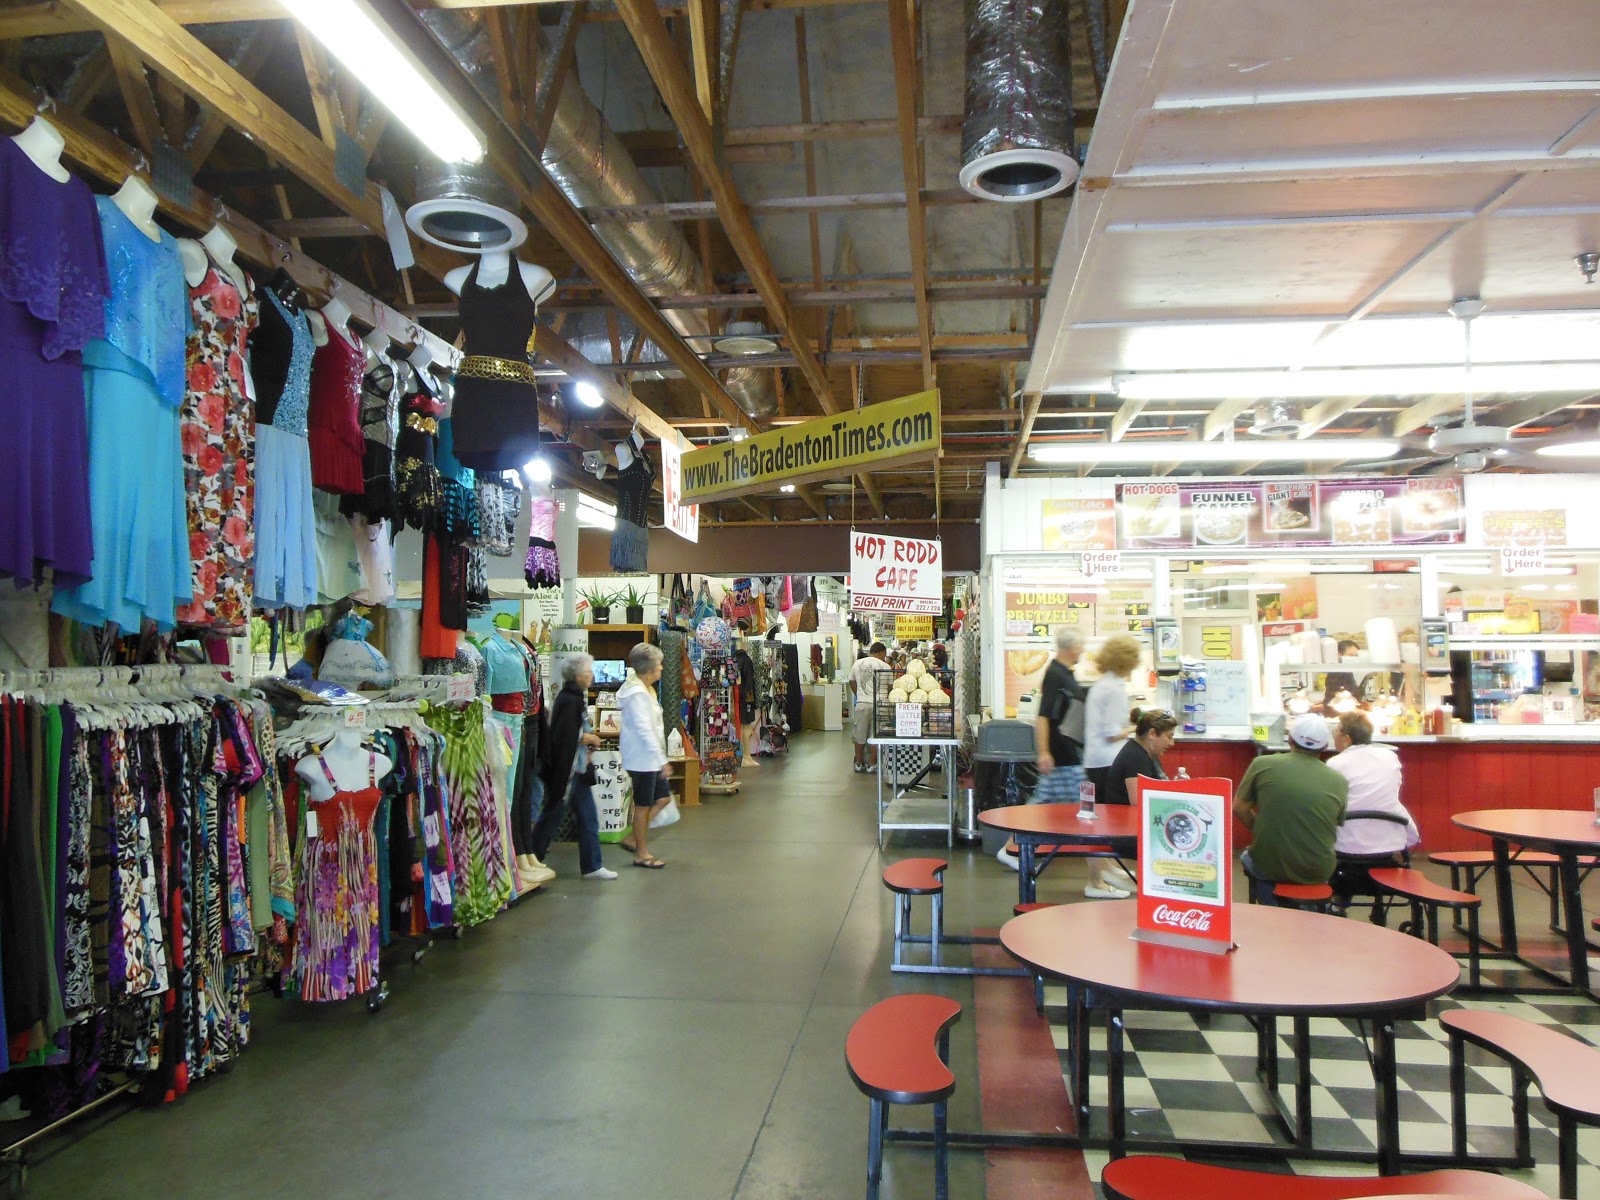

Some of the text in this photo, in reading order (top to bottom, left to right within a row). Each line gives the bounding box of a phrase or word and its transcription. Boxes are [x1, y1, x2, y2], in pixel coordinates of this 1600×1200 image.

[684, 410, 932, 491] www.TheBradentonTimes.com
[1124, 484, 1178, 495] HOT DOGS
[1408, 478, 1456, 491] PIZZA
[1192, 493, 1255, 503] FUNNEL
[1267, 491, 1291, 501] GIANT
[1080, 500, 1105, 509] Cakes
[855, 535, 938, 565] HOT RODD
[1503, 547, 1541, 558] Order
[1083, 552, 1118, 563] Order
[1093, 563, 1119, 573] Here
[1514, 559, 1542, 569] Here
[875, 565, 918, 592] CAFE
[853, 595, 880, 608] SIGN
[881, 597, 914, 610] PRINT
[1016, 592, 1067, 605] JUMBO
[1006, 609, 1079, 624] PRETZELS
[1270, 625, 1297, 635] Coca-Cola
[560, 643, 583, 652] Aloe
[1152, 903, 1214, 932] Coca-Cola
